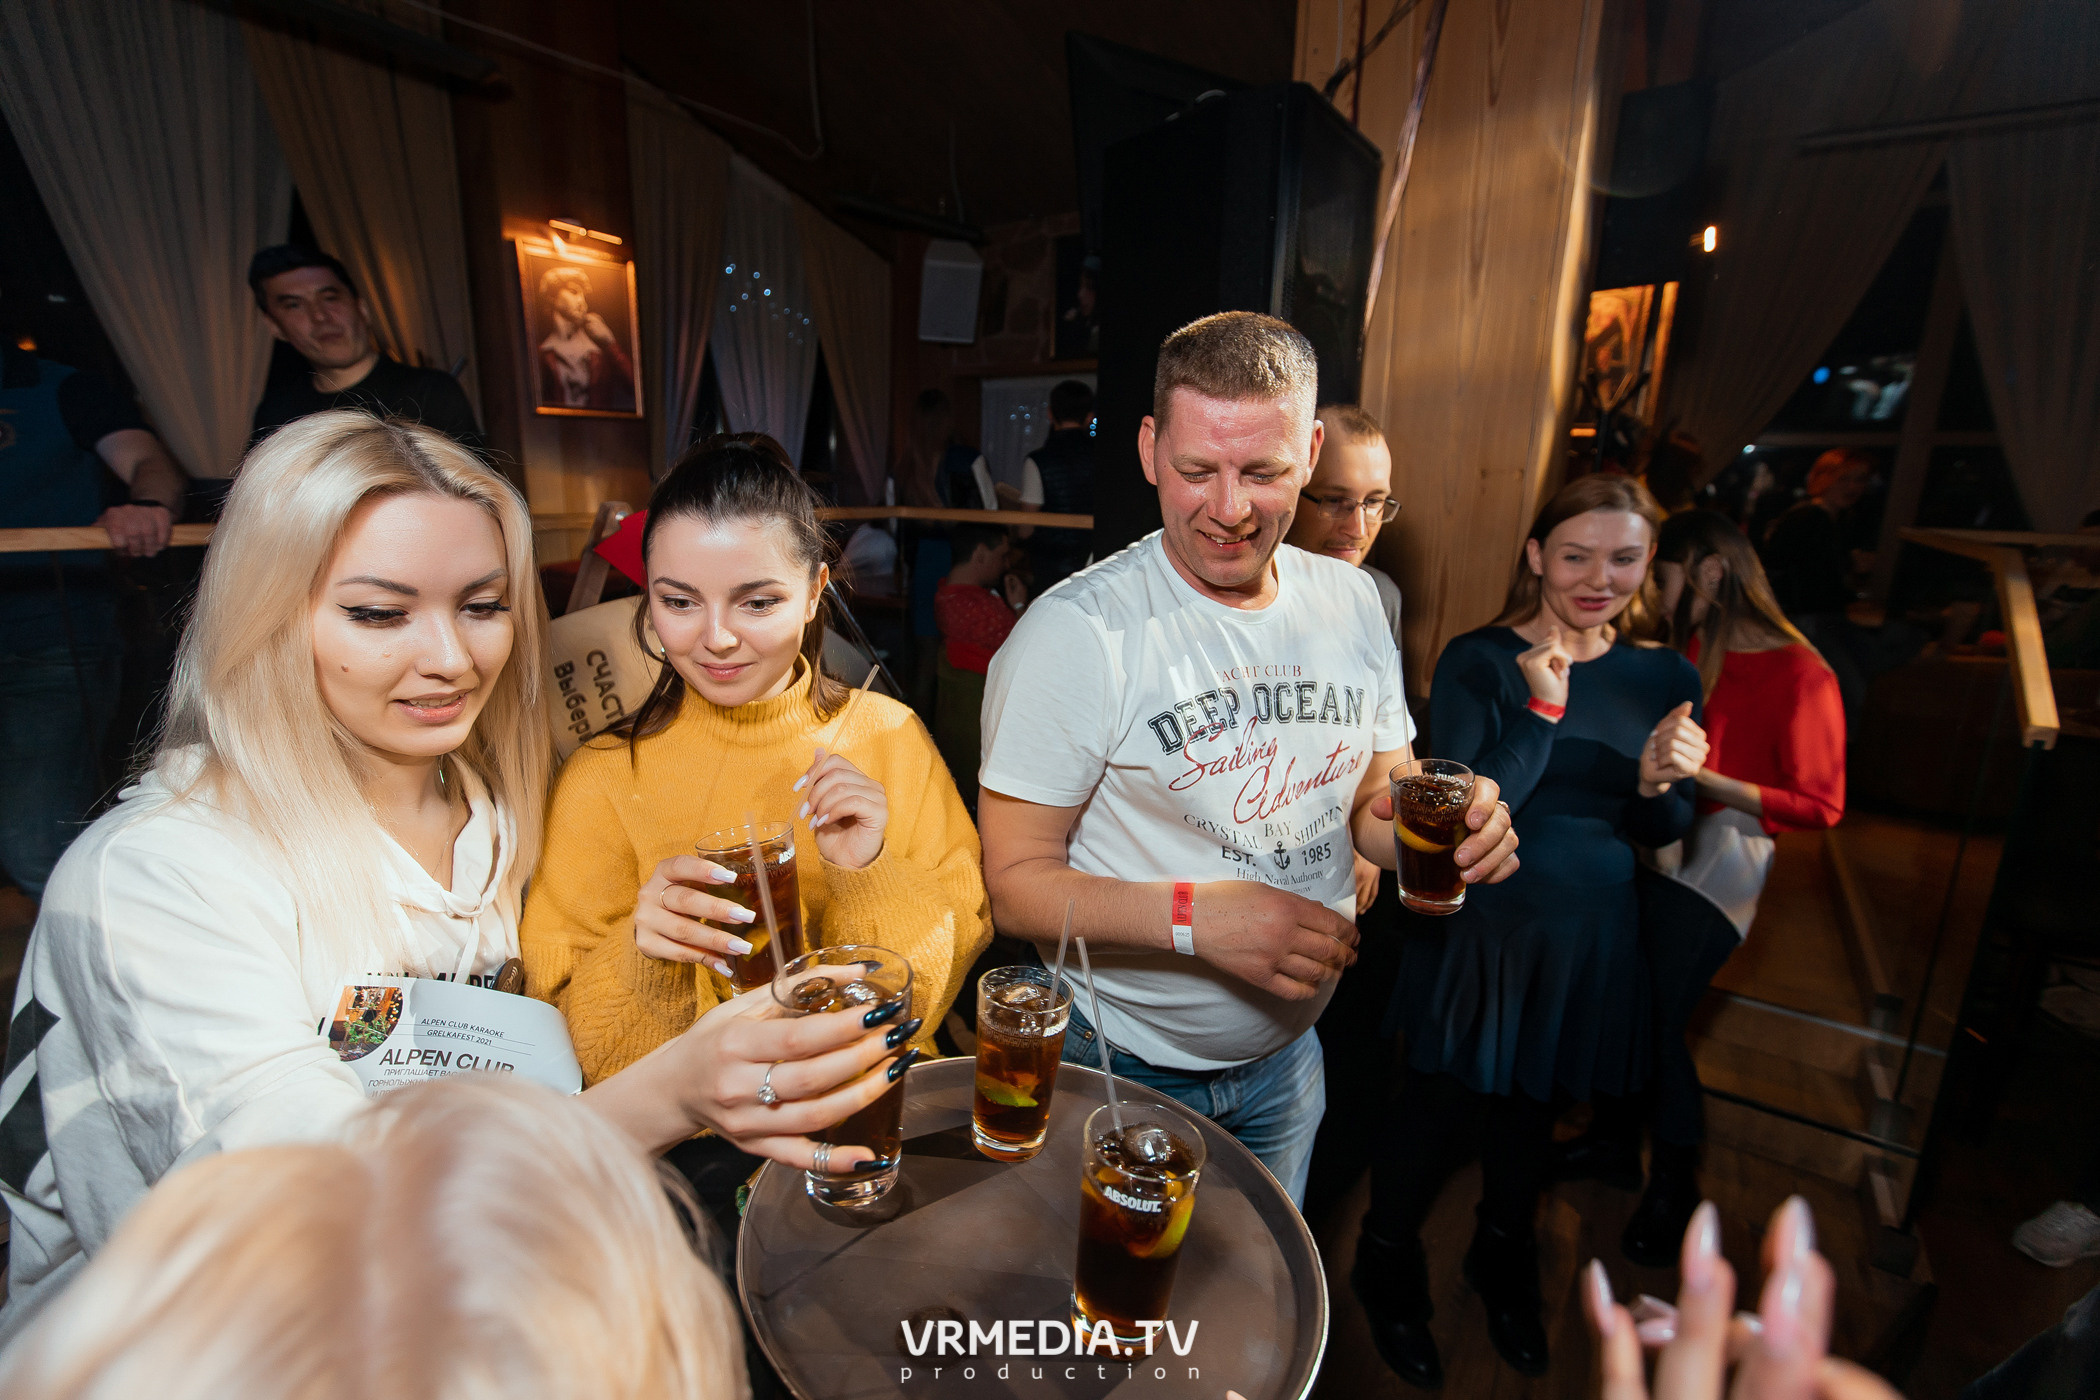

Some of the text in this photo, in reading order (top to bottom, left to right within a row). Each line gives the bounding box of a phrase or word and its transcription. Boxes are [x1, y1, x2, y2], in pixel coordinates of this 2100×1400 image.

[1216, 664, 1301, 682] ACHT CLUB
[1147, 681, 1364, 755] DEEP OCEAN
[1168, 716, 1277, 791] Sailing
[1183, 805, 1344, 850] CRYSTAL BAY SHIPPIN
[1222, 842, 1331, 867] EST. 1985
[1264, 873, 1289, 886] Naval
[1290, 868, 1324, 884] Authority
[421, 1018, 505, 1038] ALPEN CLUB KARAOKE
[426, 1029, 492, 1046] GRELKAFEST 2021
[379, 1048, 453, 1068] ALPEN
[383, 1068, 440, 1077] ПРИГЛАШАЕТ
